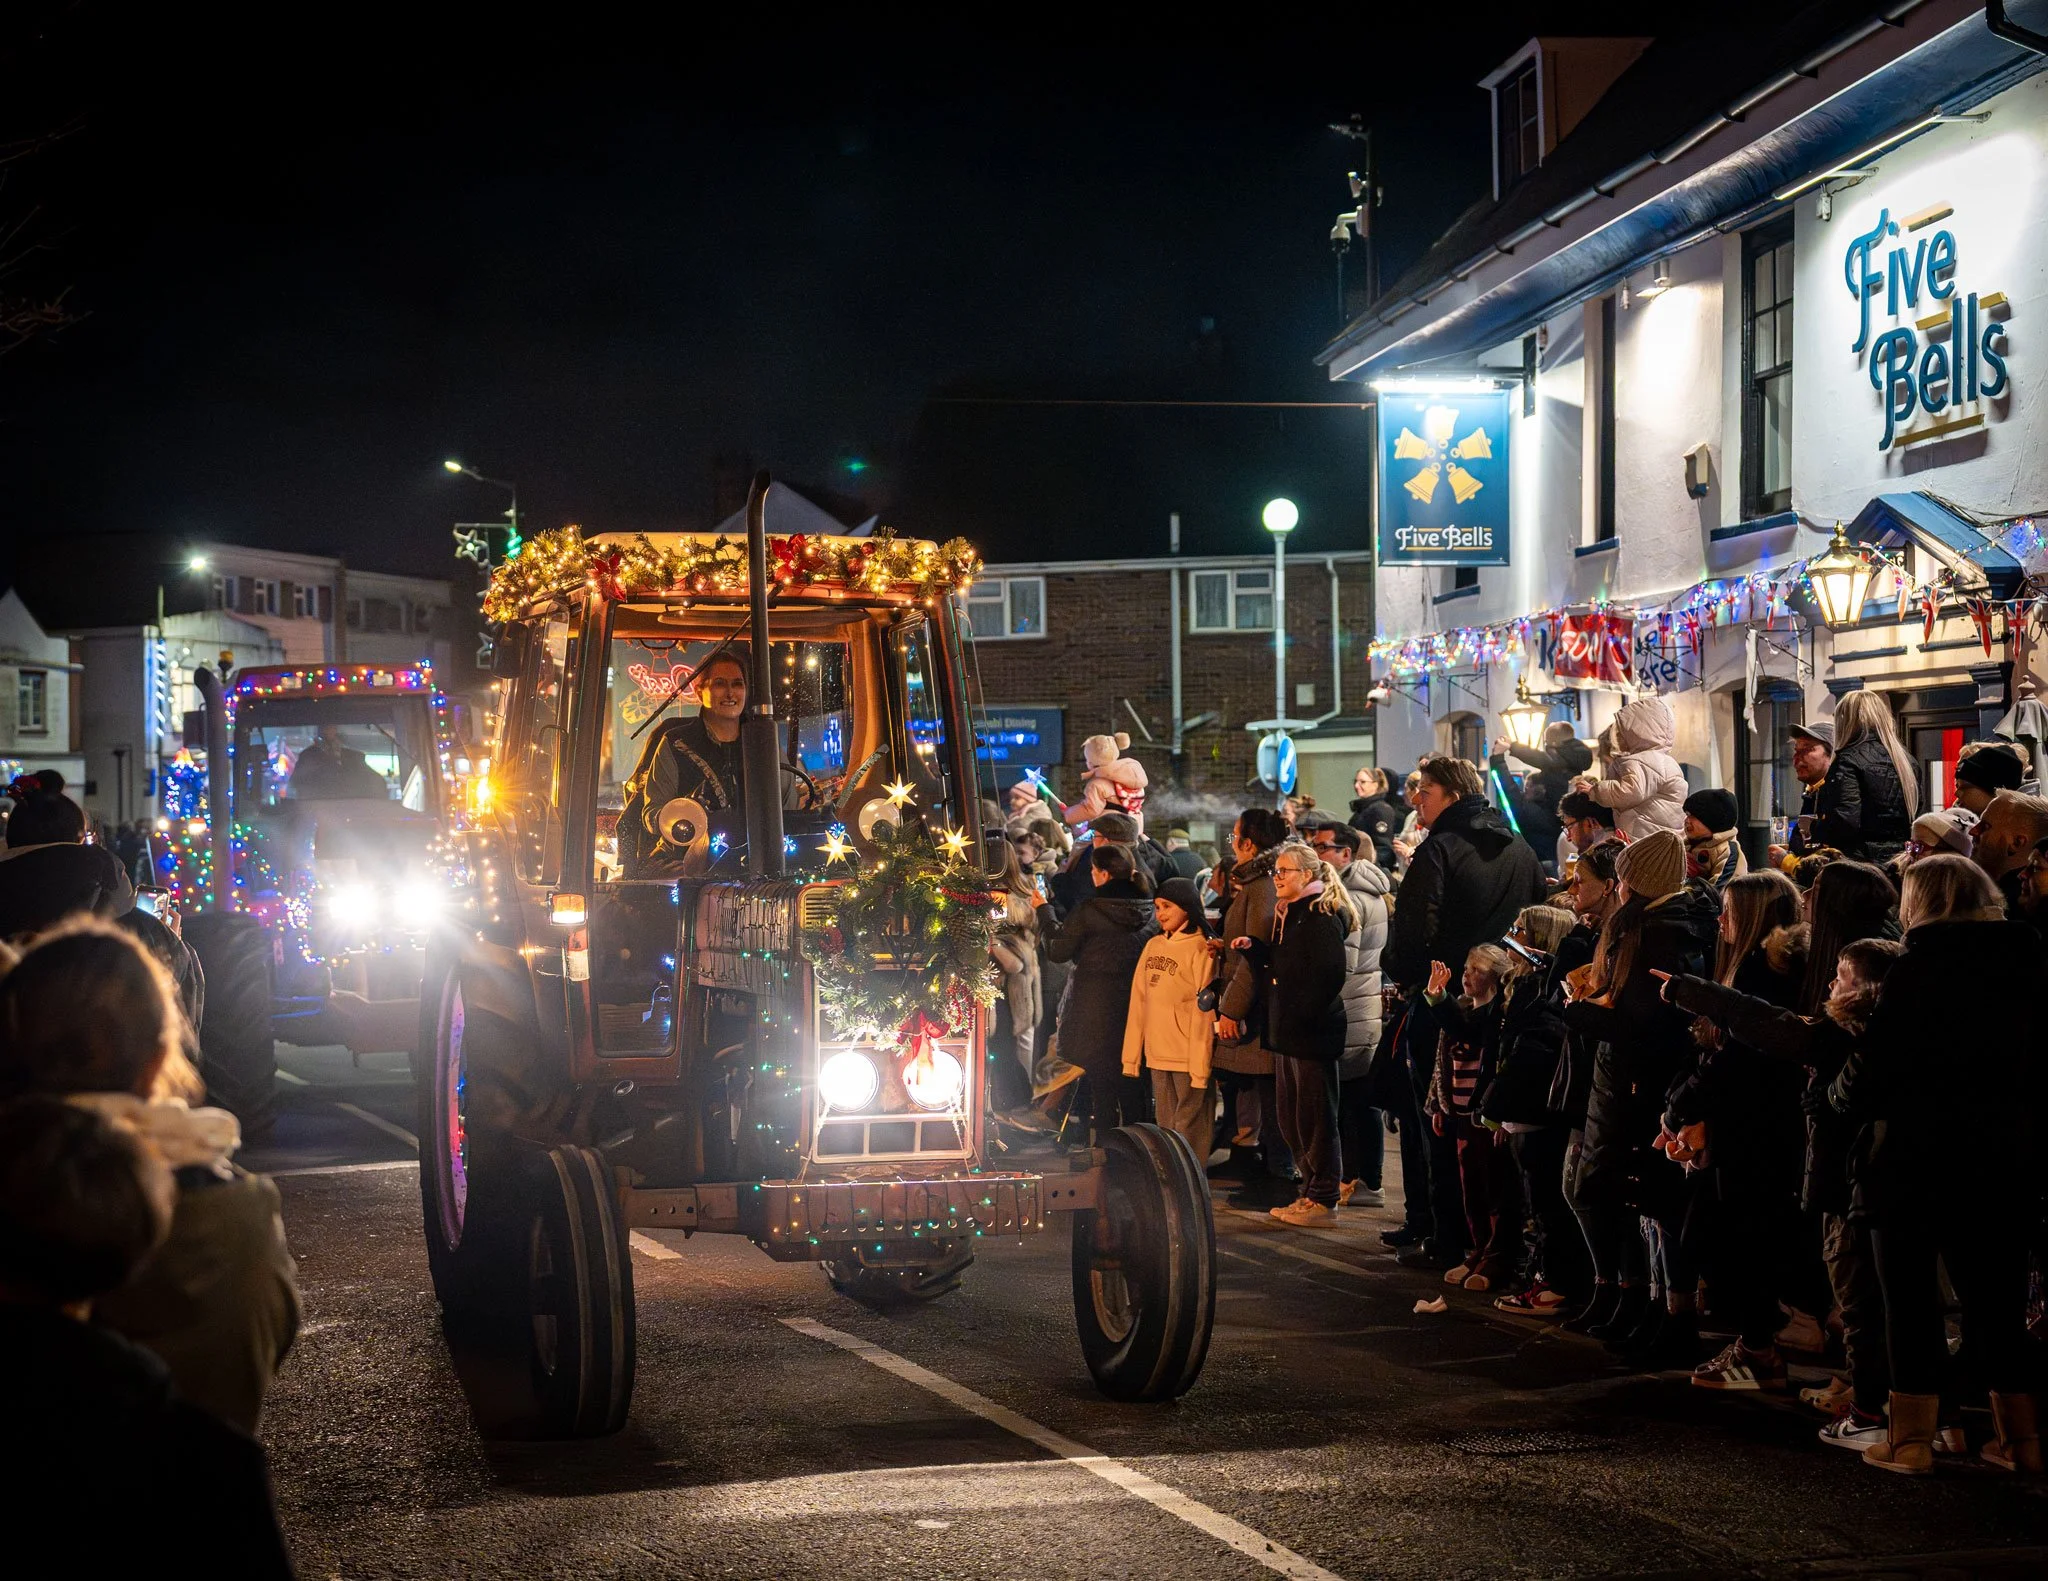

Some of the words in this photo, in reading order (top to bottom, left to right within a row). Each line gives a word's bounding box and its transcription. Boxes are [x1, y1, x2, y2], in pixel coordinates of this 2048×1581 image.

[1844, 208, 1956, 353] Five
[1869, 292, 2007, 451] Bells
[1395, 525, 1439, 550] Five
[1442, 524, 1493, 550] Bells
